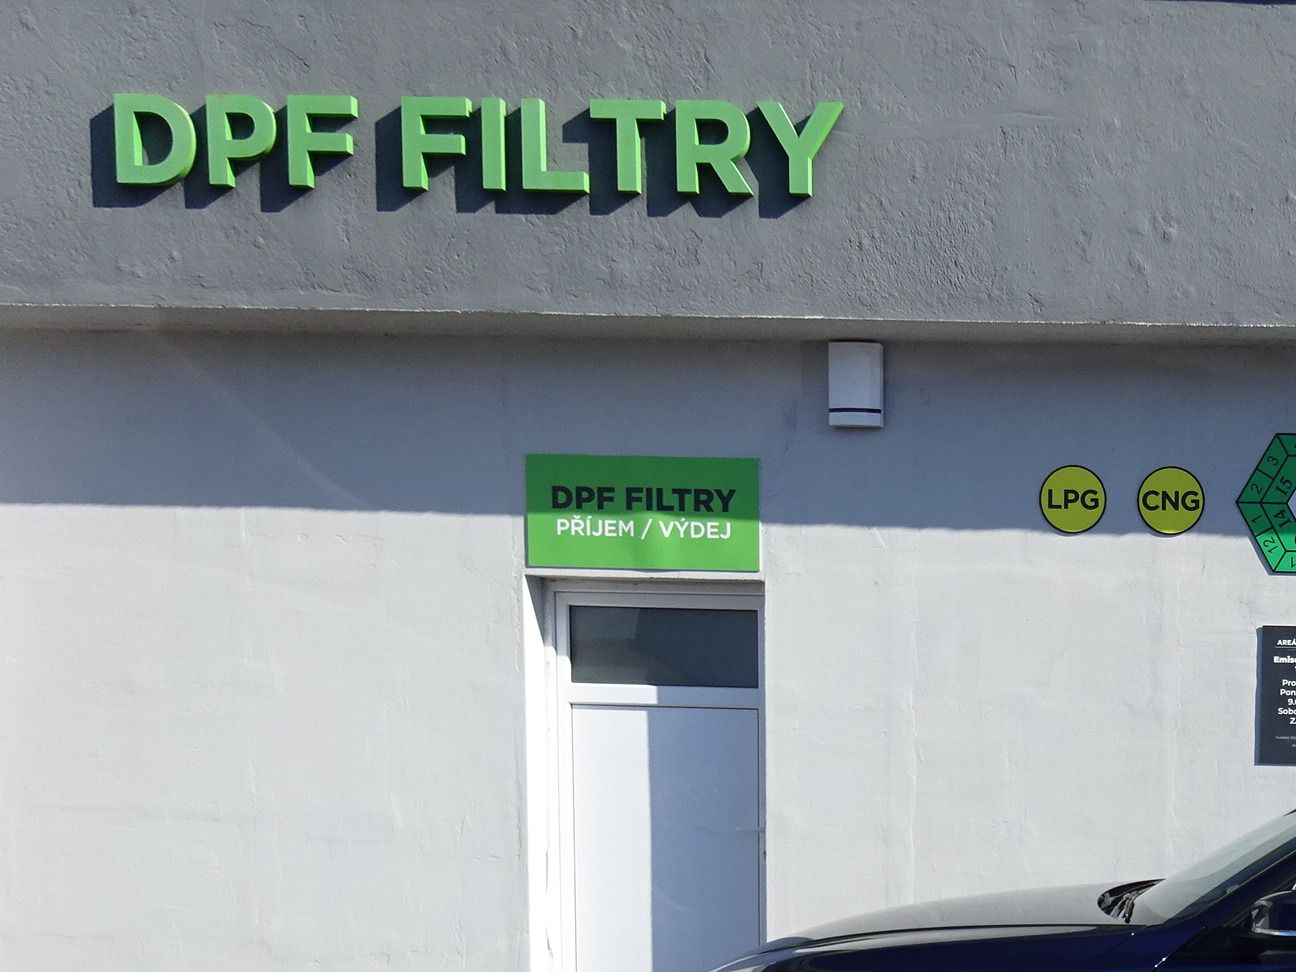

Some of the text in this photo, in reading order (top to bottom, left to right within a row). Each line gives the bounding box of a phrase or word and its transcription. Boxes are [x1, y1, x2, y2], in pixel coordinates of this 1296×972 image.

[113, 93, 845, 197] DPF FILTRY
[1267, 456, 1278, 466] 3
[1251, 484, 1263, 495] 2
[1276, 476, 1293, 495] 15
[551, 485, 737, 513] DPF FILTRY
[1047, 489, 1100, 511] LPG
[1142, 490, 1200, 512] CNG
[556, 515, 732, 540] PŘÍJEM / VÝDEJ
[1251, 515, 1261, 524] 1
[1273, 509, 1292, 528] 14
[1263, 536, 1278, 554] 12
